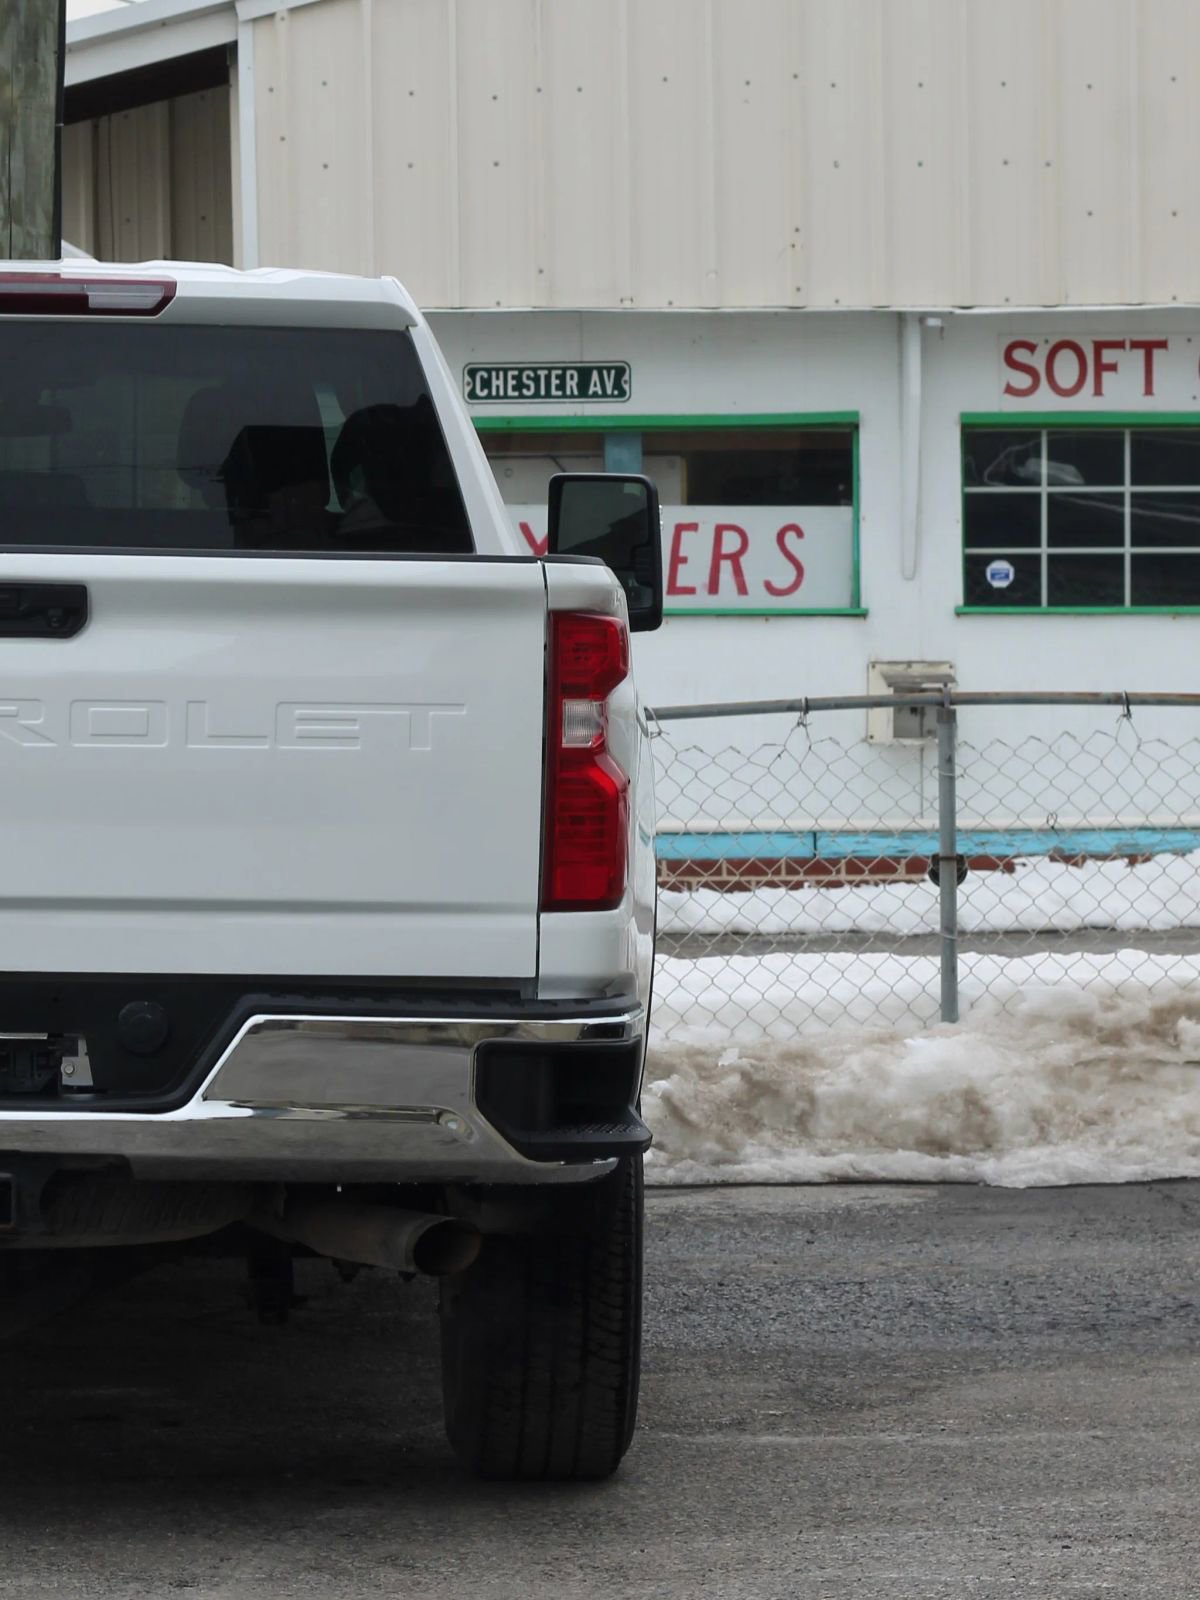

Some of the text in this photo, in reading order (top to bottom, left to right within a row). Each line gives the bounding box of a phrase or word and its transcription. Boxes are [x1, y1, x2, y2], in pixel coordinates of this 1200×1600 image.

[475, 369, 619, 397] CHESTER AV.
[1003, 339, 1169, 398] SOFT
